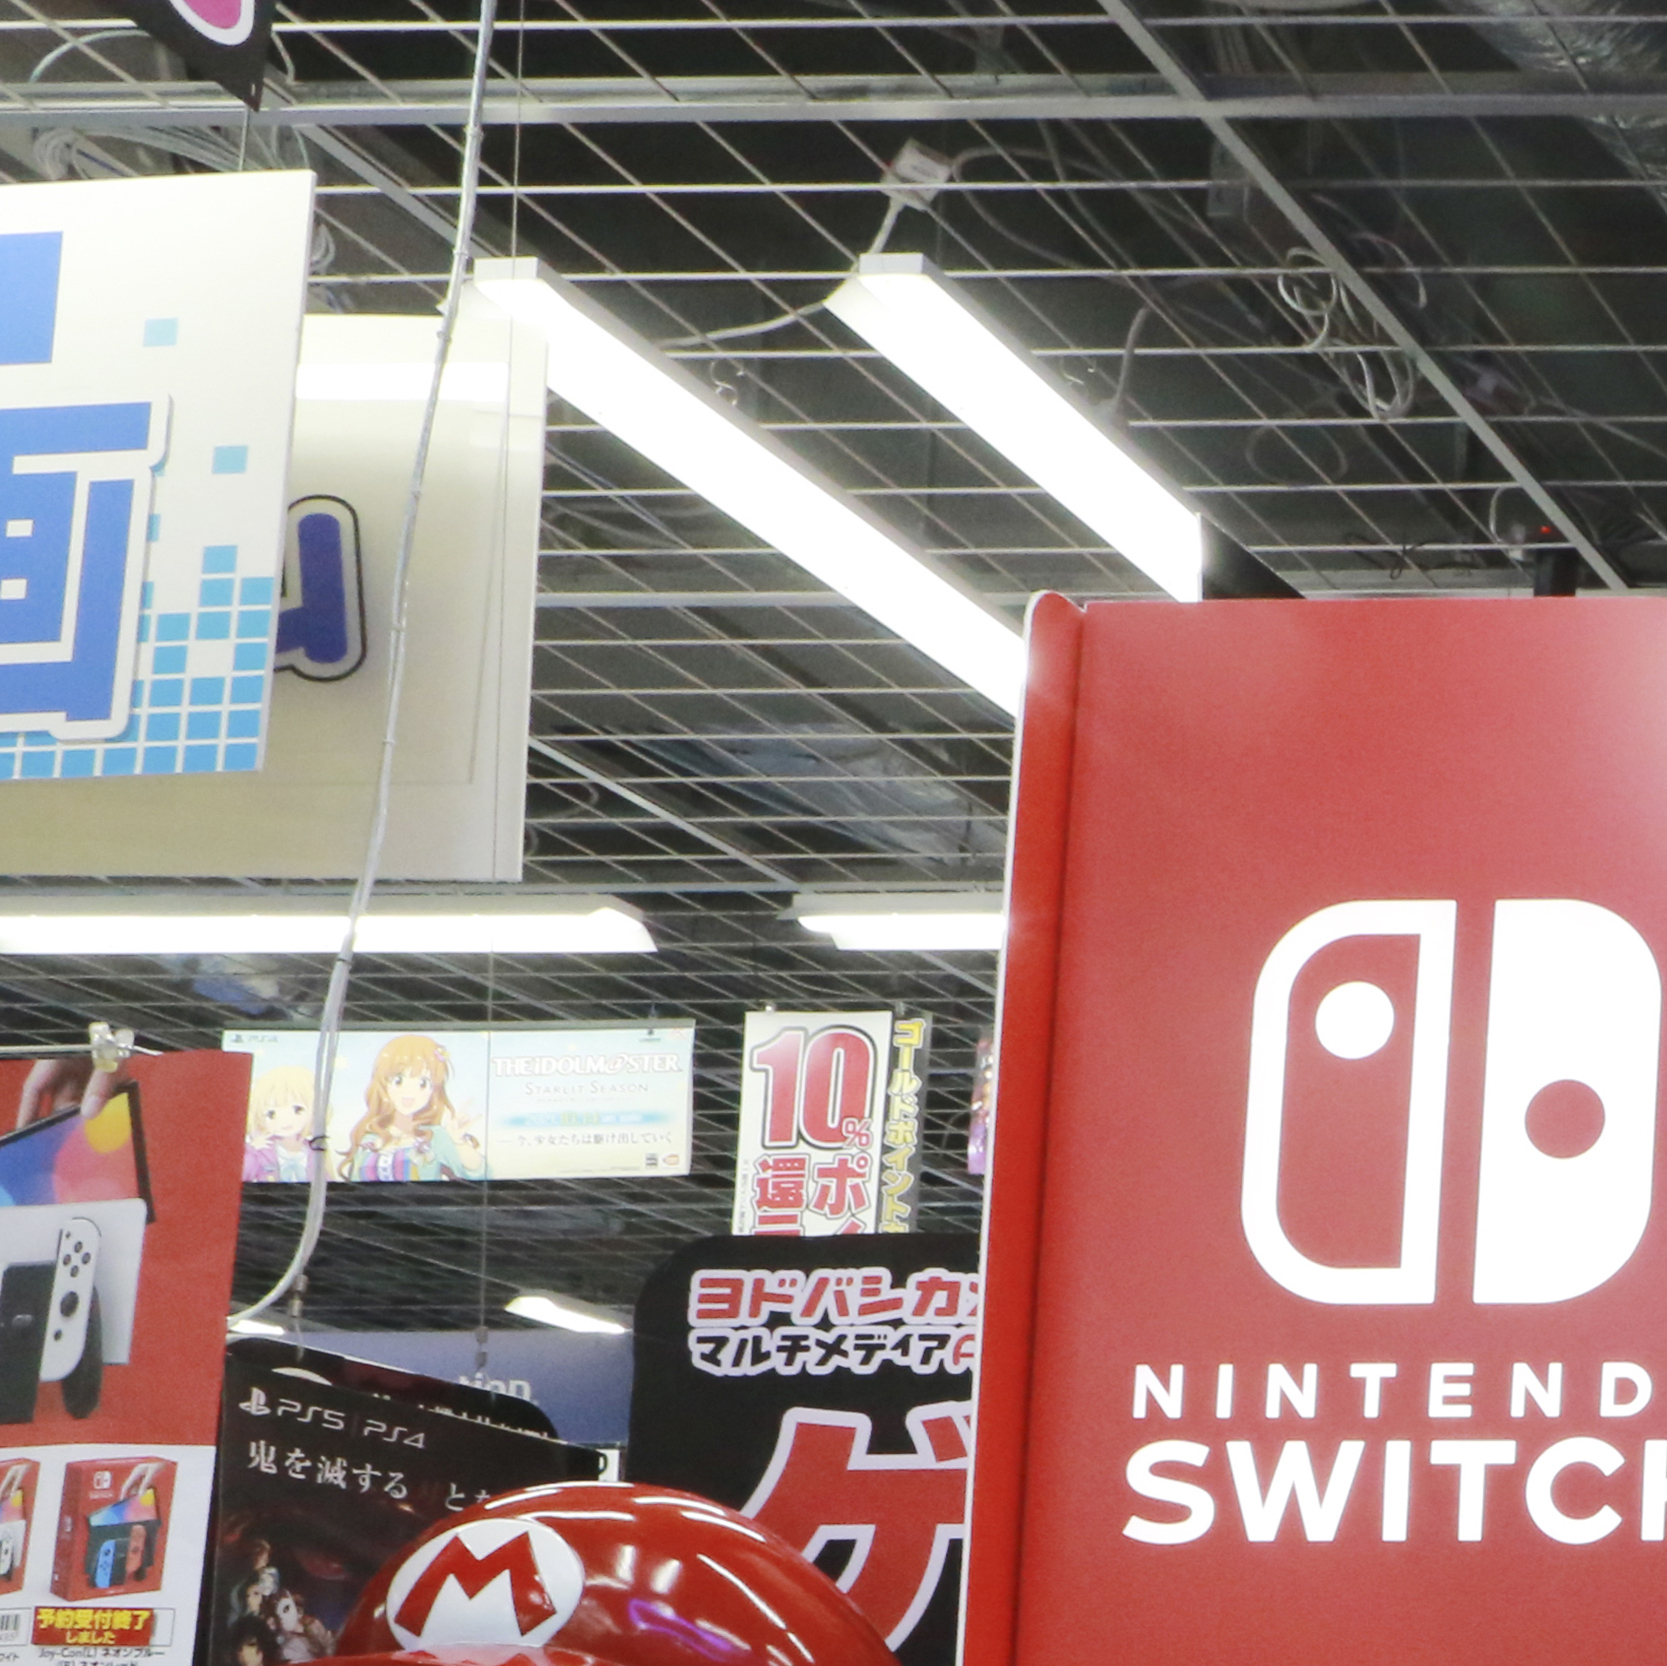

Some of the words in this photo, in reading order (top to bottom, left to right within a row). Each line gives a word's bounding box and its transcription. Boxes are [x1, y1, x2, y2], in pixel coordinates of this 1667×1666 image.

[277, 1398, 345, 1431] PS5
[363, 1418, 426, 1451] PS4
[394, 1530, 557, 1638] M
[37, 1608, 150, 1629] 予約受付終了
[65, 1631, 116, 1645] しました
